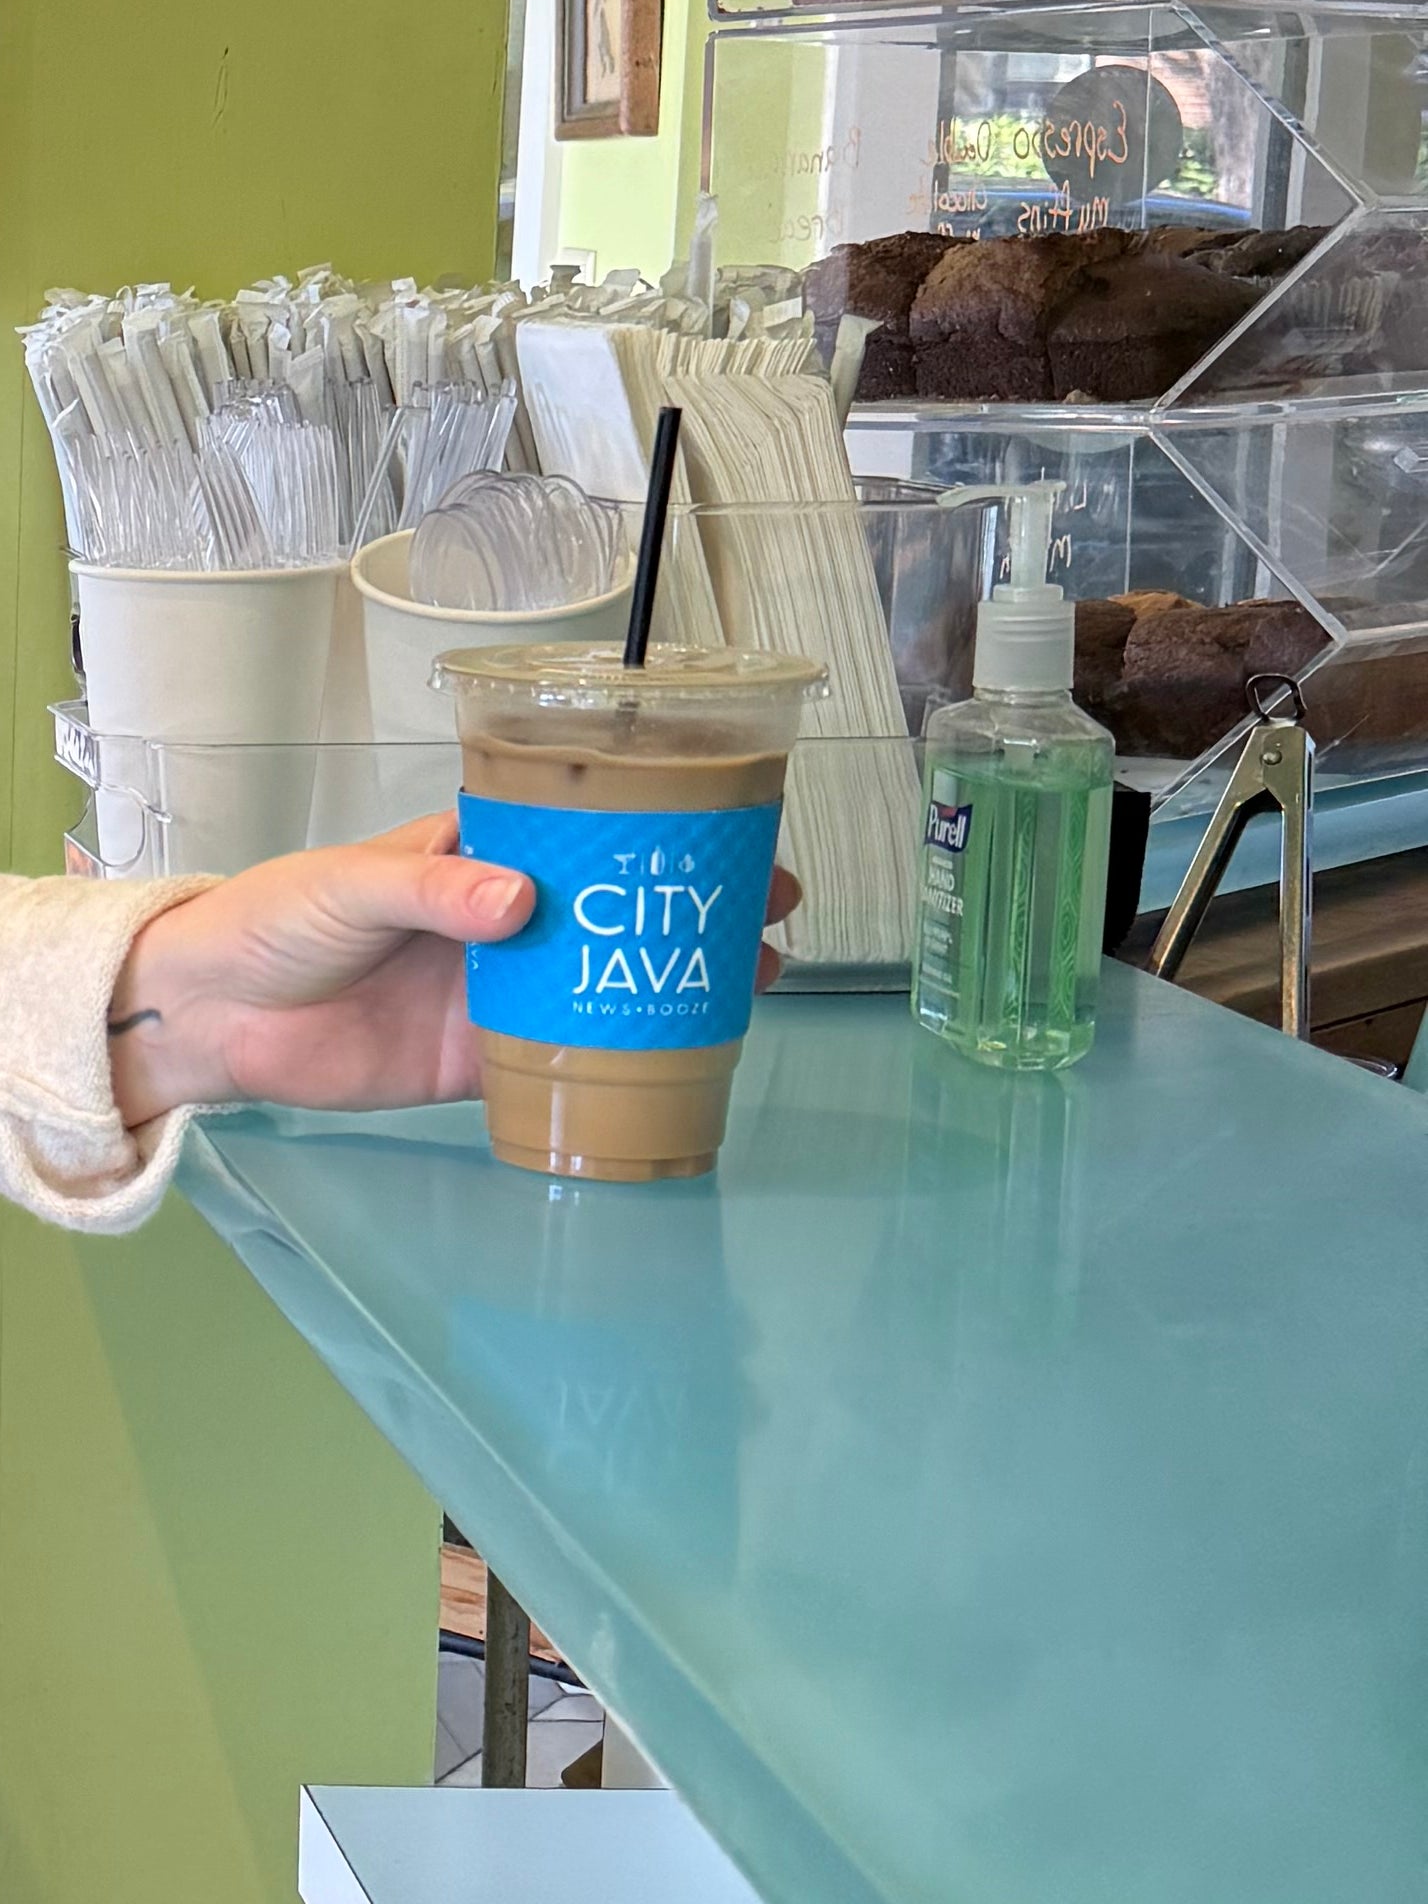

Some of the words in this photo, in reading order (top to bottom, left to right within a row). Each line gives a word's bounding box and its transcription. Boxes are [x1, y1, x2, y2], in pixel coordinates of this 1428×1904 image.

[928, 803, 968, 849] Purell
[573, 883, 723, 936] CITY
[572, 944, 711, 995] JAVA
